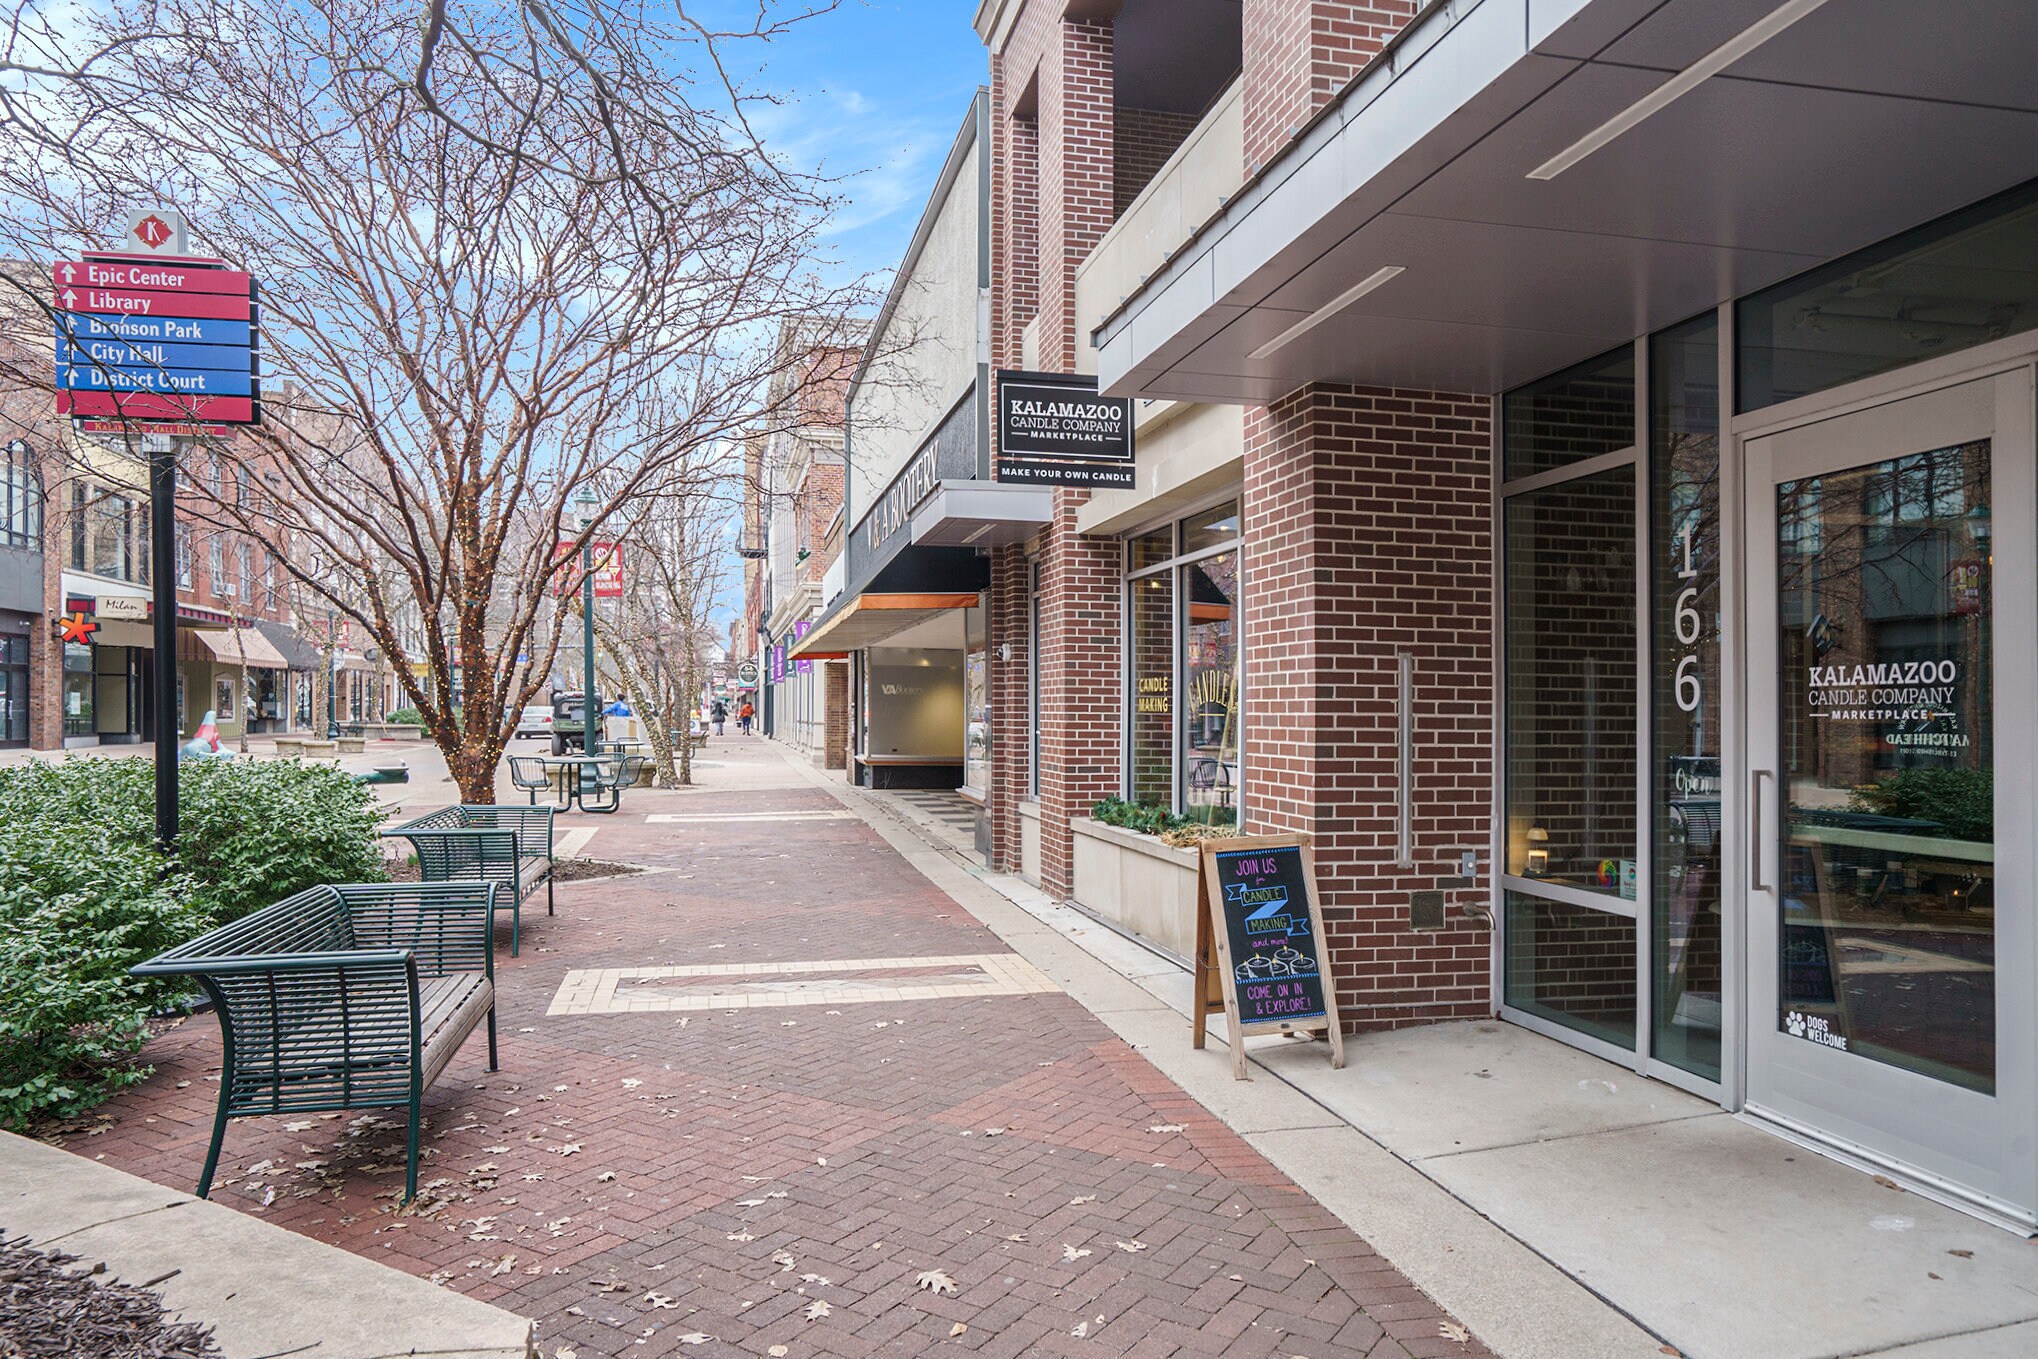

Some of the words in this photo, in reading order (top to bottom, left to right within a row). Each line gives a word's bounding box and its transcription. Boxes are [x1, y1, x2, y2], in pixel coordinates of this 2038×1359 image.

[88, 265, 125, 287] Epic
[129, 267, 185, 287] Center
[89, 291, 151, 314] Library
[90, 317, 160, 337] Bronson
[165, 320, 202, 339] Park
[90, 343, 125, 364] City
[129, 345, 163, 362] Hall
[90, 368, 154, 388] District
[158, 371, 206, 389] Court
[1010, 399, 1122, 421] KALAMAZOO
[1010, 416, 1060, 430] CANDLE
[1062, 419, 1121, 433] COMPANY
[1030, 431, 1104, 442] MARKETPLACE
[1001, 467, 1031, 477] MAKE
[1033, 468, 1062, 478] YOUR
[1064, 470, 1089, 480] OWN
[1092, 472, 1132, 482] CANDLE
[890, 439, 939, 534] BOOTERY
[1808, 659, 1957, 687] KALAMAZOO
[1138, 676, 1168, 692] CANDLE
[1138, 697, 1168, 713] MAKING
[1808, 689, 1867, 706] CANDLE
[1871, 686, 1955, 706] COMPANY
[1831, 709, 1928, 720] MARKETPLACE
[1675, 767, 1714, 800] Open
[1235, 859, 1259, 876] JOIN
[1261, 857, 1277, 874] US
[1255, 876, 1265, 886] for
[1242, 887, 1283, 903] CANDLE
[1250, 917, 1287, 932] MAKING
[1252, 938, 1269, 948] and
[1247, 984, 1273, 1000] COME
[1277, 984, 1289, 997] ON
[1293, 982, 1304, 995] IN
[1255, 1001, 1263, 1015] &
[1265, 996, 1312, 1014] EXPLORE!
[1807, 1015, 1829, 1032] DOGS
[1807, 1027, 1847, 1051] WELCOME
